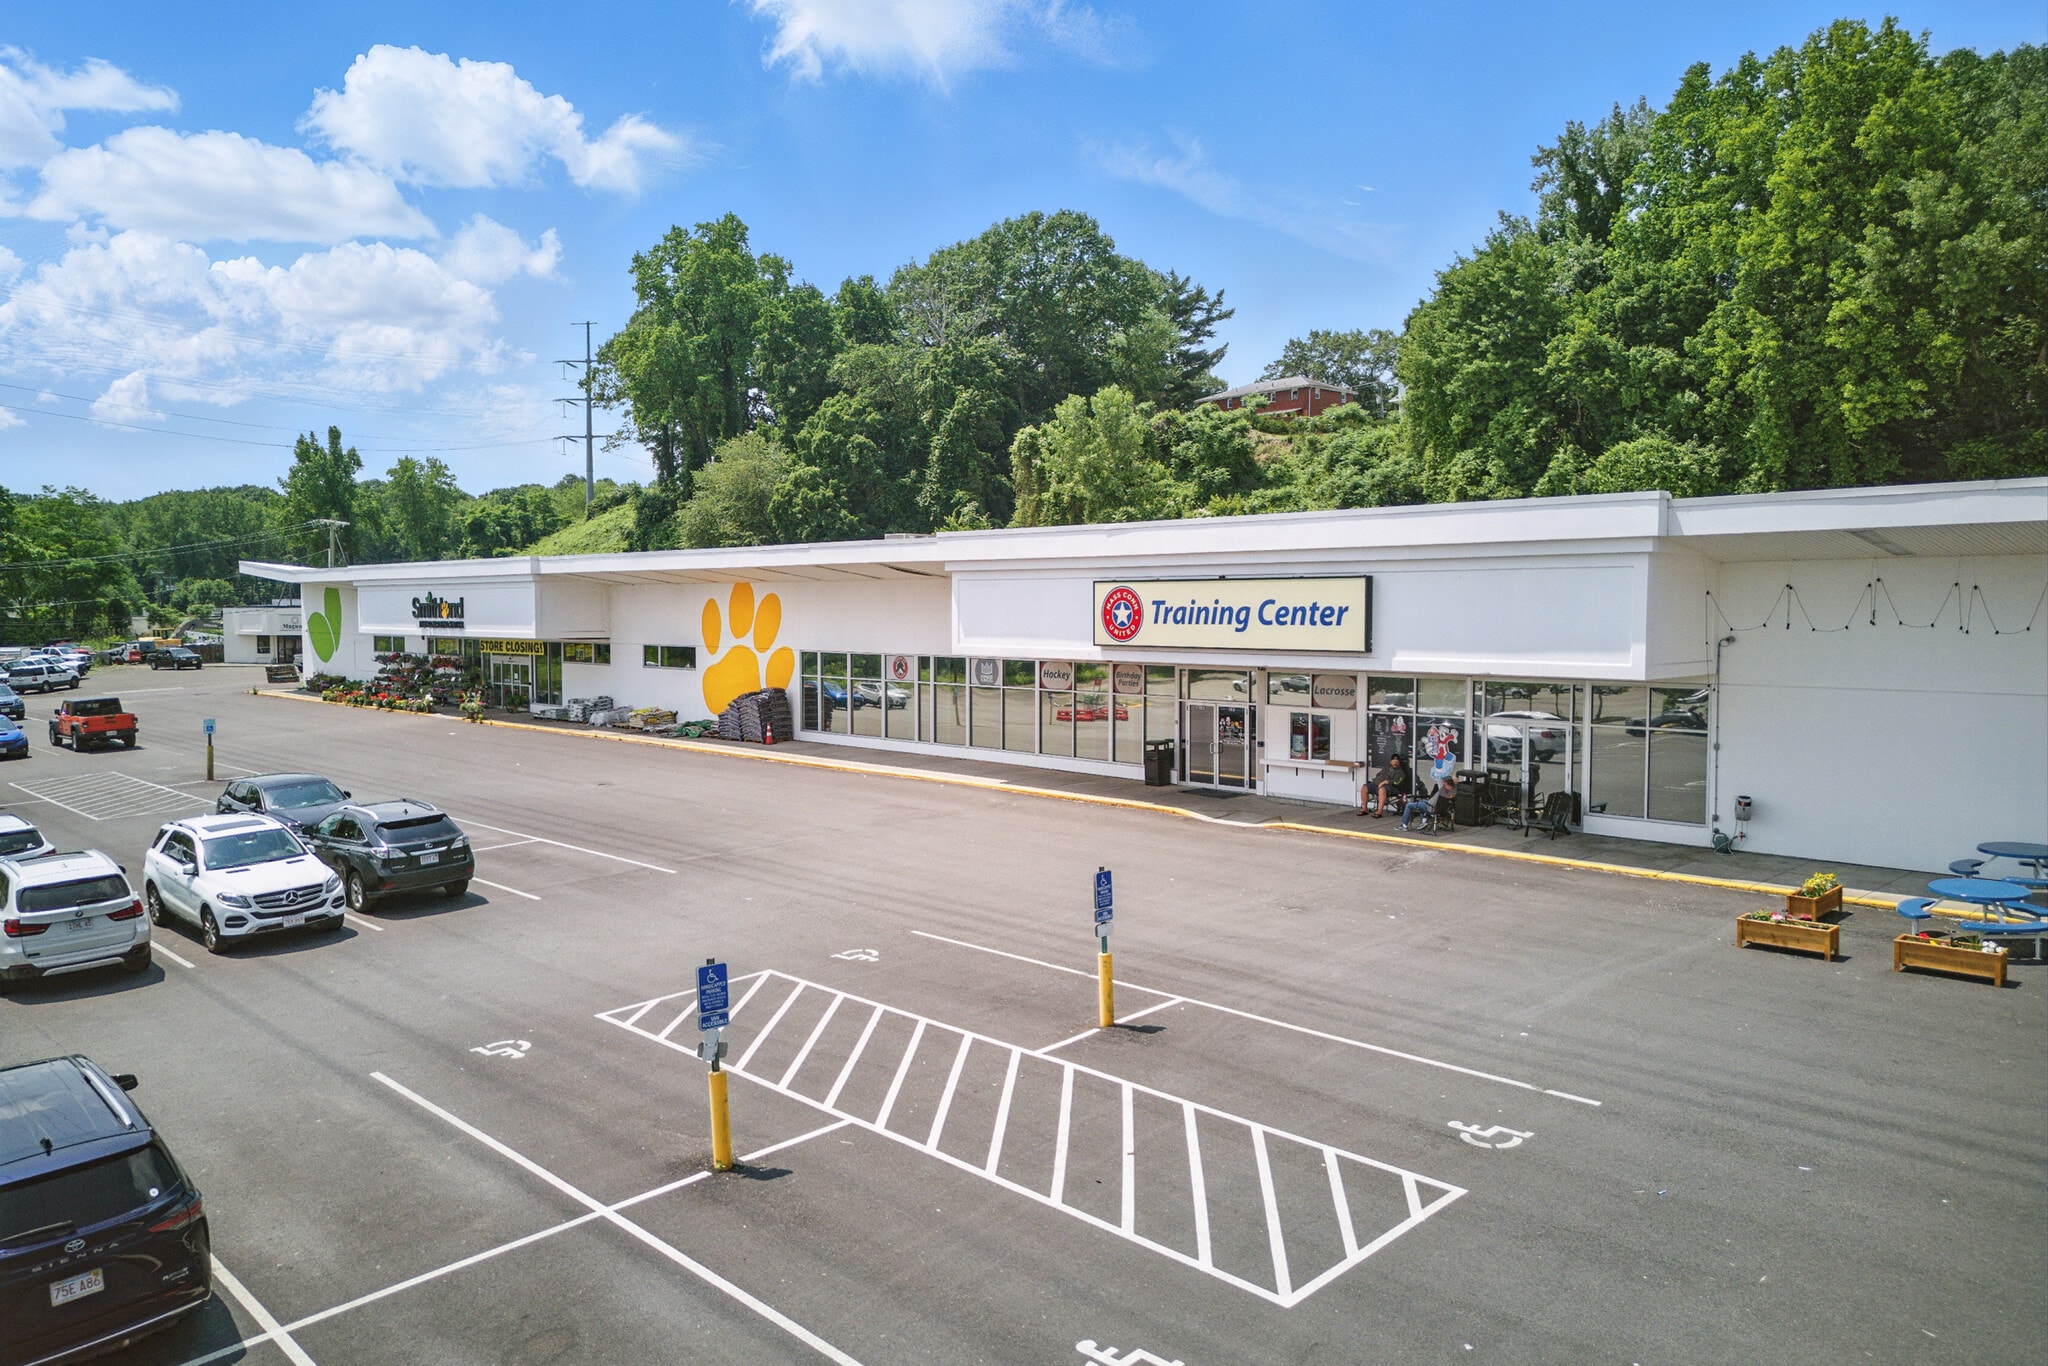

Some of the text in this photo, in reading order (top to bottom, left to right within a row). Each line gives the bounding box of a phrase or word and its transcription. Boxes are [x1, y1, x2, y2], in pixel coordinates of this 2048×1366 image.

[1106, 592, 1139, 610] MASS CONN
[1151, 599, 1350, 633] Training Center
[1109, 624, 1135, 636] UNITED
[480, 640, 544, 654] STORE CLOSING!
[1043, 669, 1071, 681] Hockey
[1116, 671, 1142, 681] Birthday
[1118, 679, 1139, 687] Parties
[1314, 685, 1356, 696] Lacrosse
[31, 1241, 119, 1273] SIENNA
[53, 1277, 101, 1300] 75E A86
